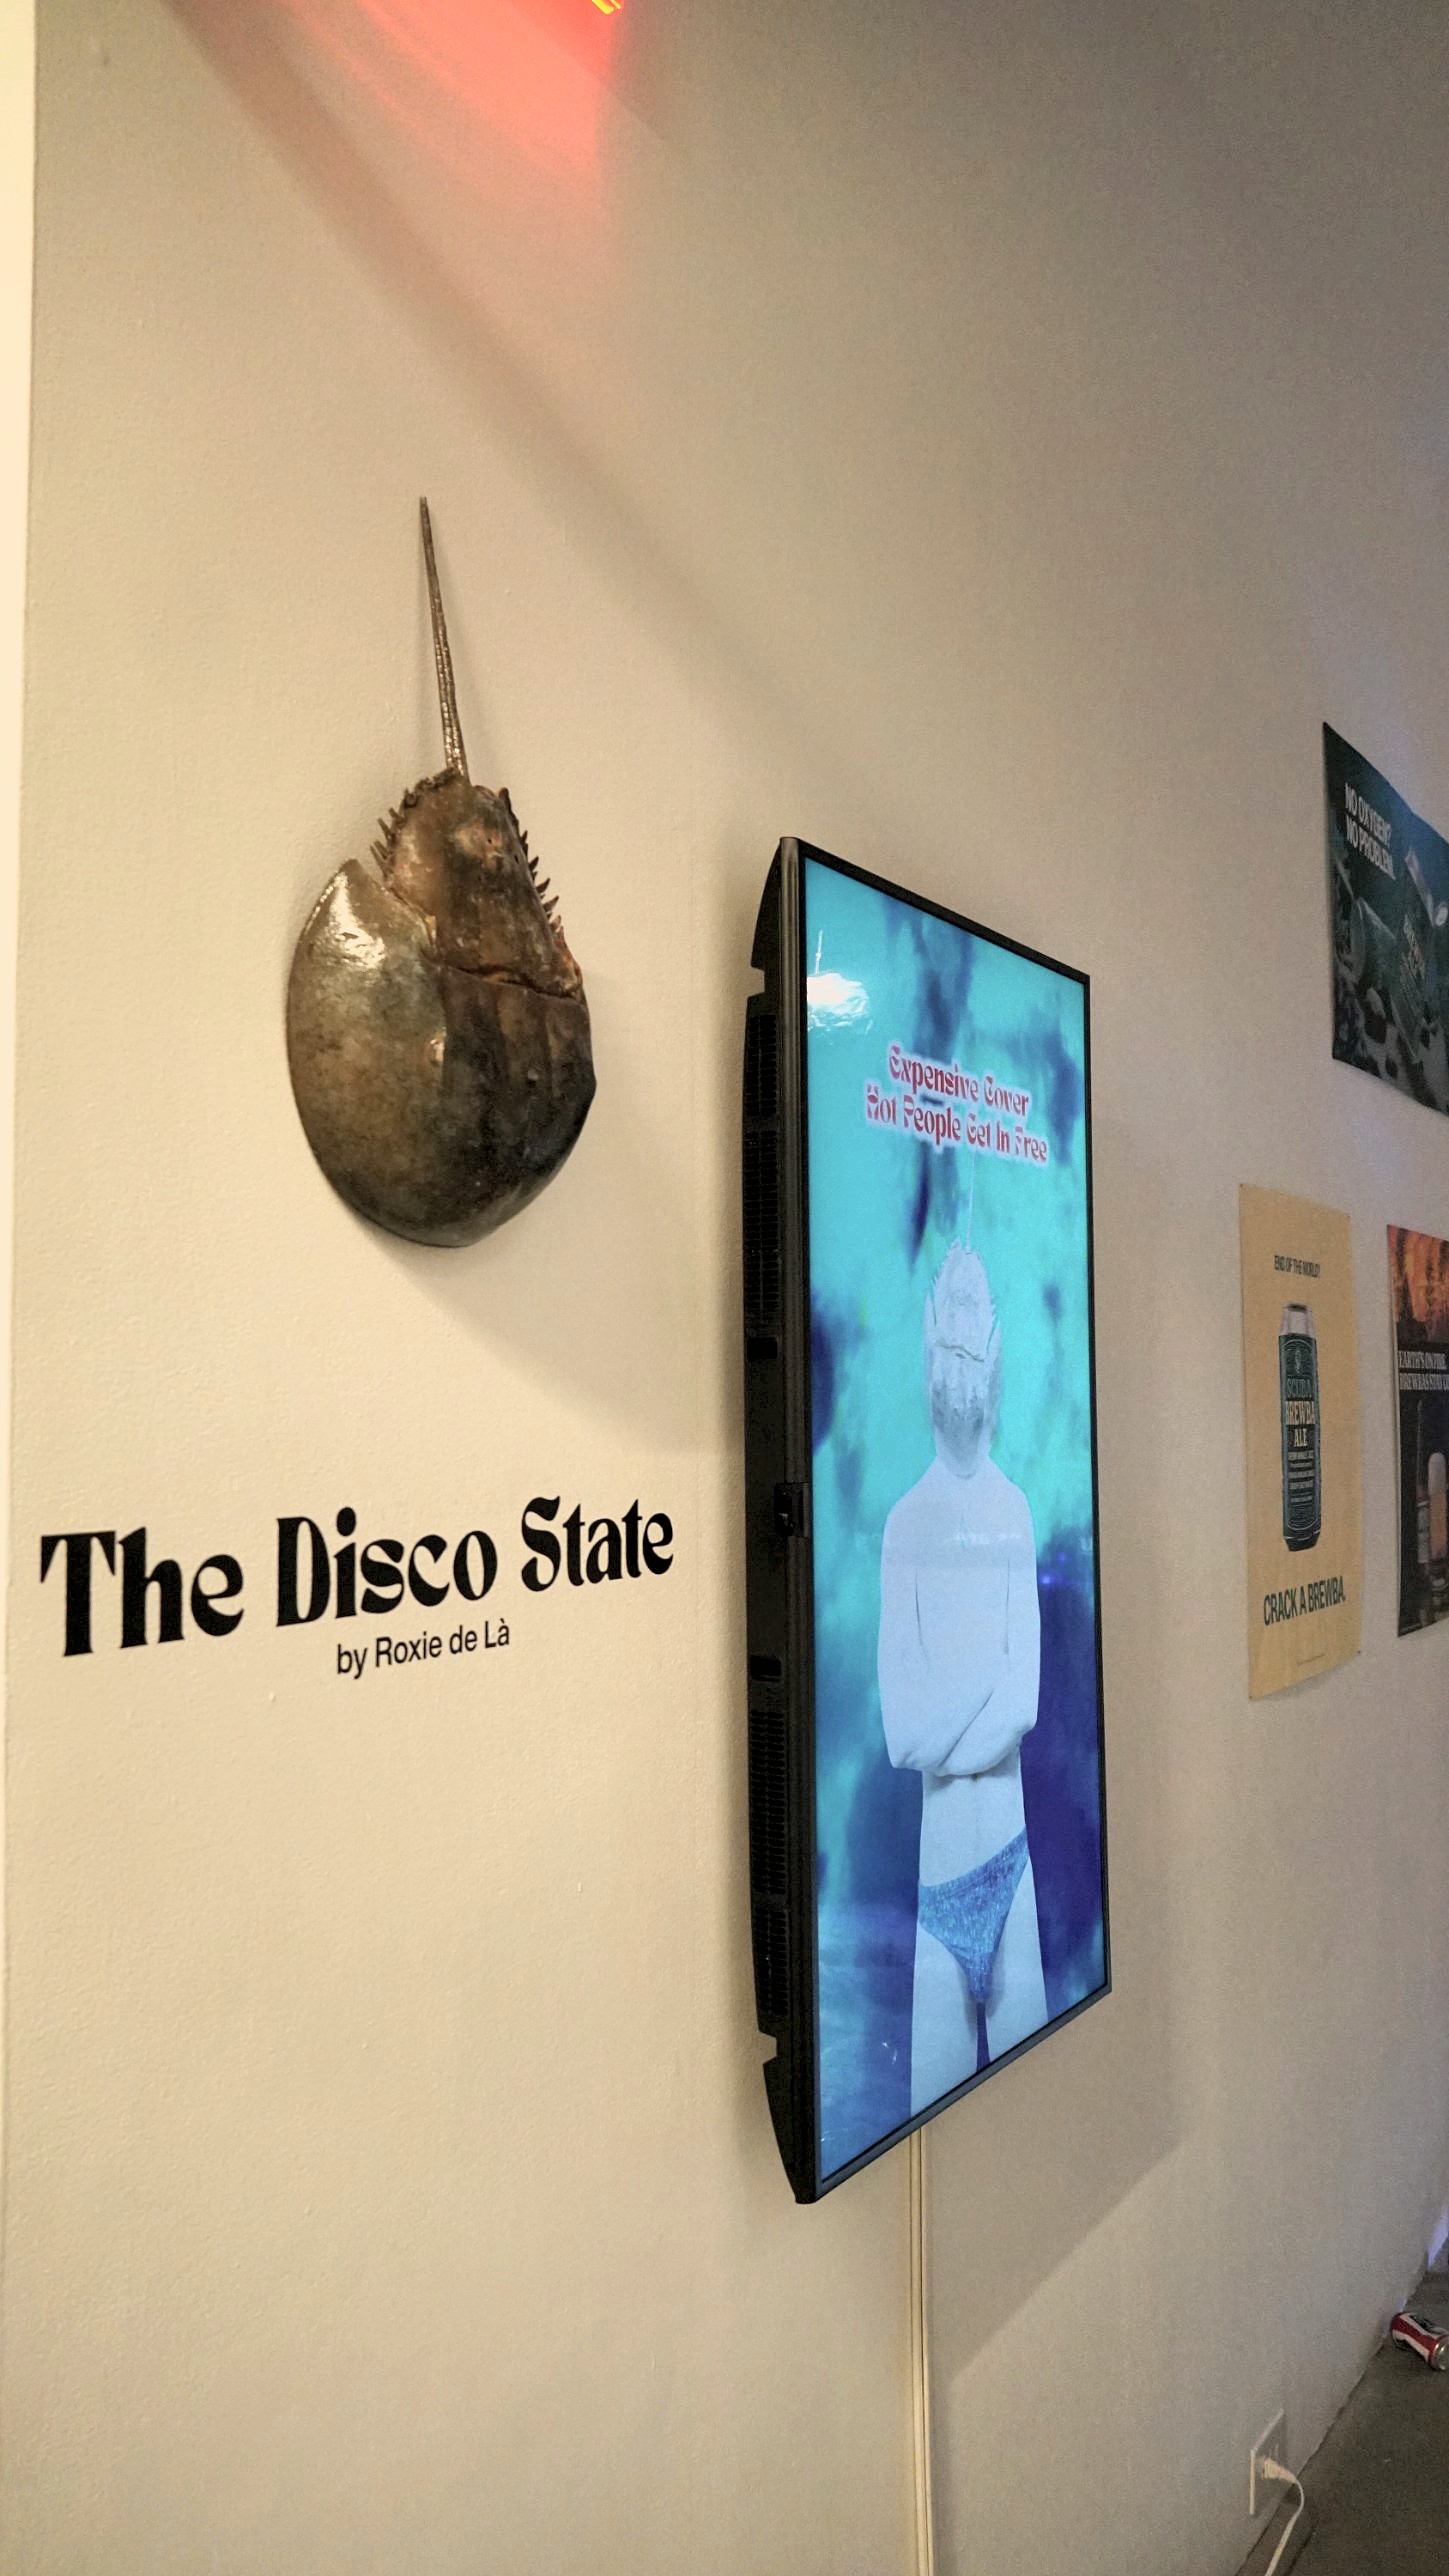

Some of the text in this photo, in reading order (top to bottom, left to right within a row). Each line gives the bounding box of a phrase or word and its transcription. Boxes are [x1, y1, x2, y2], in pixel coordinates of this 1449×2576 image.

[1345, 782, 1358, 816] NO
[1346, 814, 1359, 849] NO
[888, 1044, 1030, 1117] Expensive Cover
[866, 1083, 1048, 1163] Hot People Get In Free
[1292, 1258, 1302, 1275] THE
[1285, 1400, 1316, 1425] BREWBA
[1294, 1428, 1308, 1448] ALE
[40, 1495, 674, 1657] The Disco State
[1263, 1575, 1346, 1627] CRACK A BREWBA.
[336, 1617, 511, 1679] by Roxie de Là
